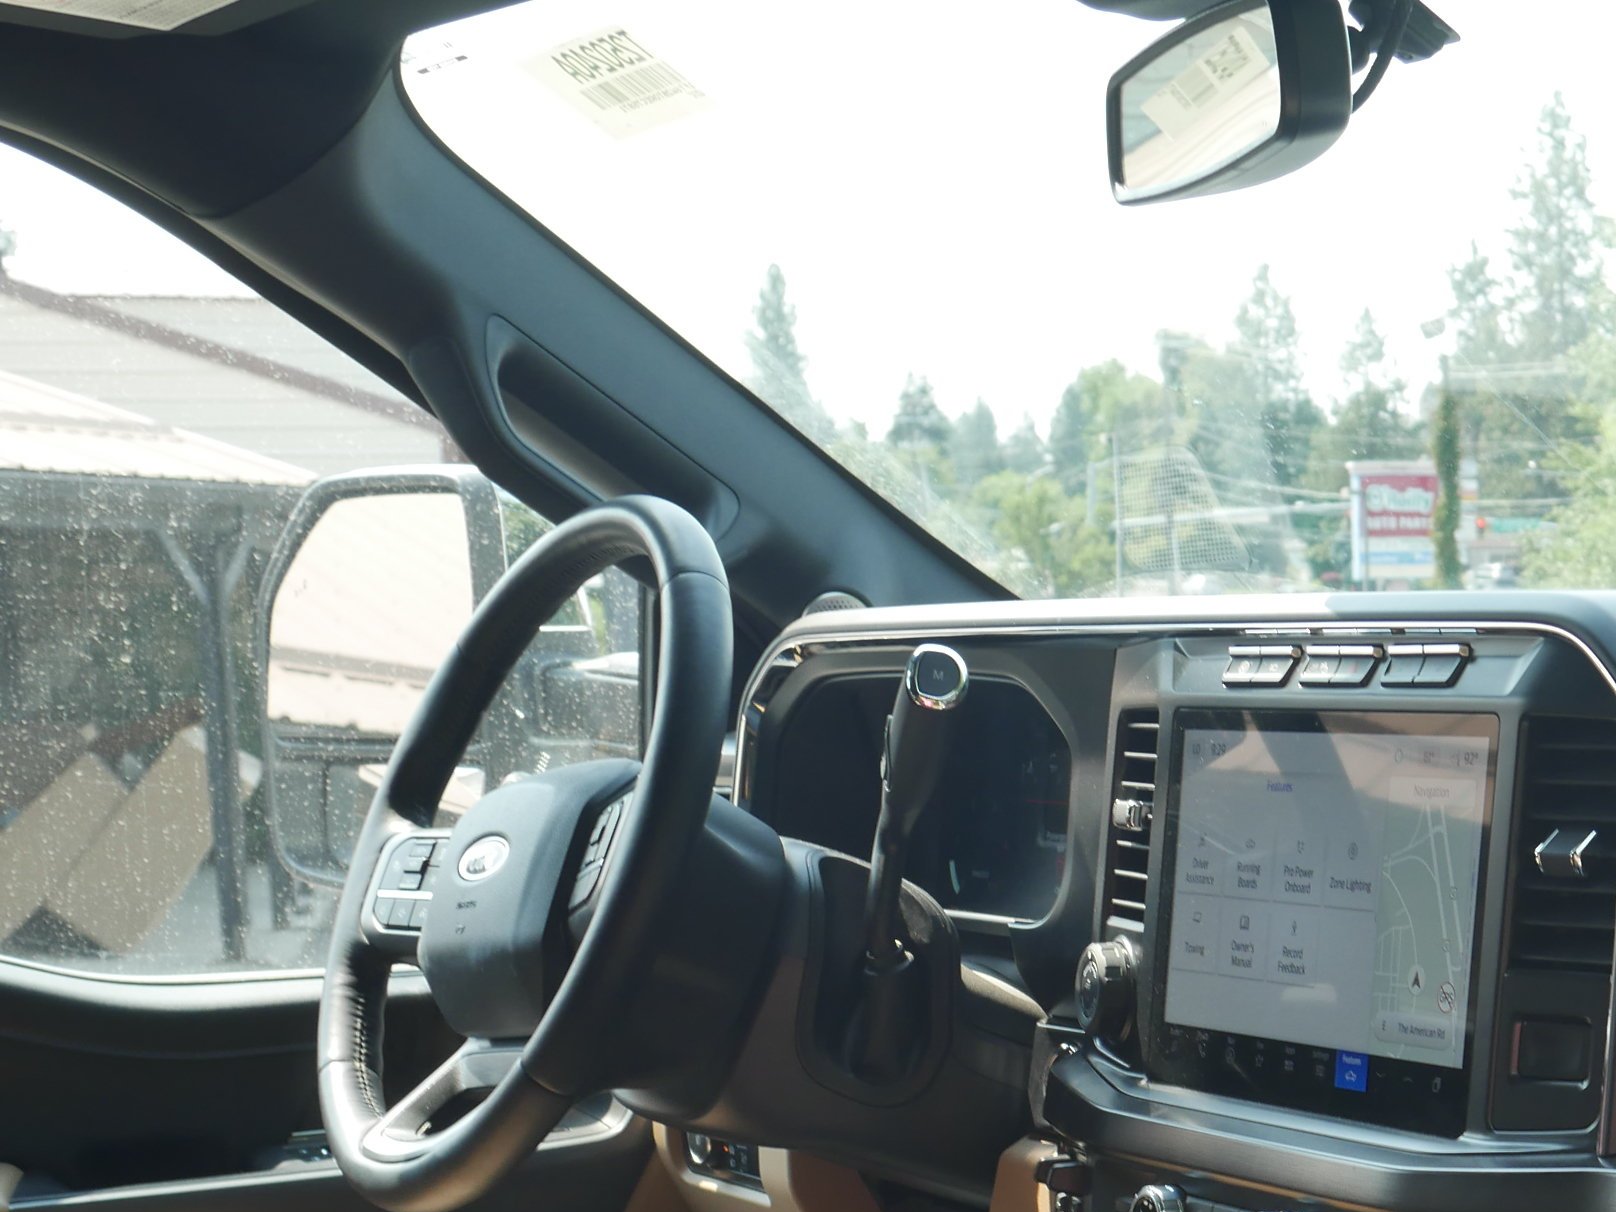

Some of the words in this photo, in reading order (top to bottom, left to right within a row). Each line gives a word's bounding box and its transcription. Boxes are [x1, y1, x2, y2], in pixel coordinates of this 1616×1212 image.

[1266, 780, 1294, 793] Features
[1413, 784, 1451, 799] Navigation
[1236, 861, 1261, 877] Running
[1295, 866, 1314, 879] Power
[1237, 878, 1258, 890] Boards
[1284, 880, 1311, 895] Onboard
[1329, 876, 1347, 891] Zone
[1347, 879, 1372, 894] Lighting
[1184, 941, 1205, 957] Towing
[1282, 946, 1304, 960] Record
[1231, 955, 1252, 968] Manual
[1277, 961, 1306, 976] Feedback
[1398, 1022, 1410, 1035] The
[1410, 1025, 1436, 1037] American
